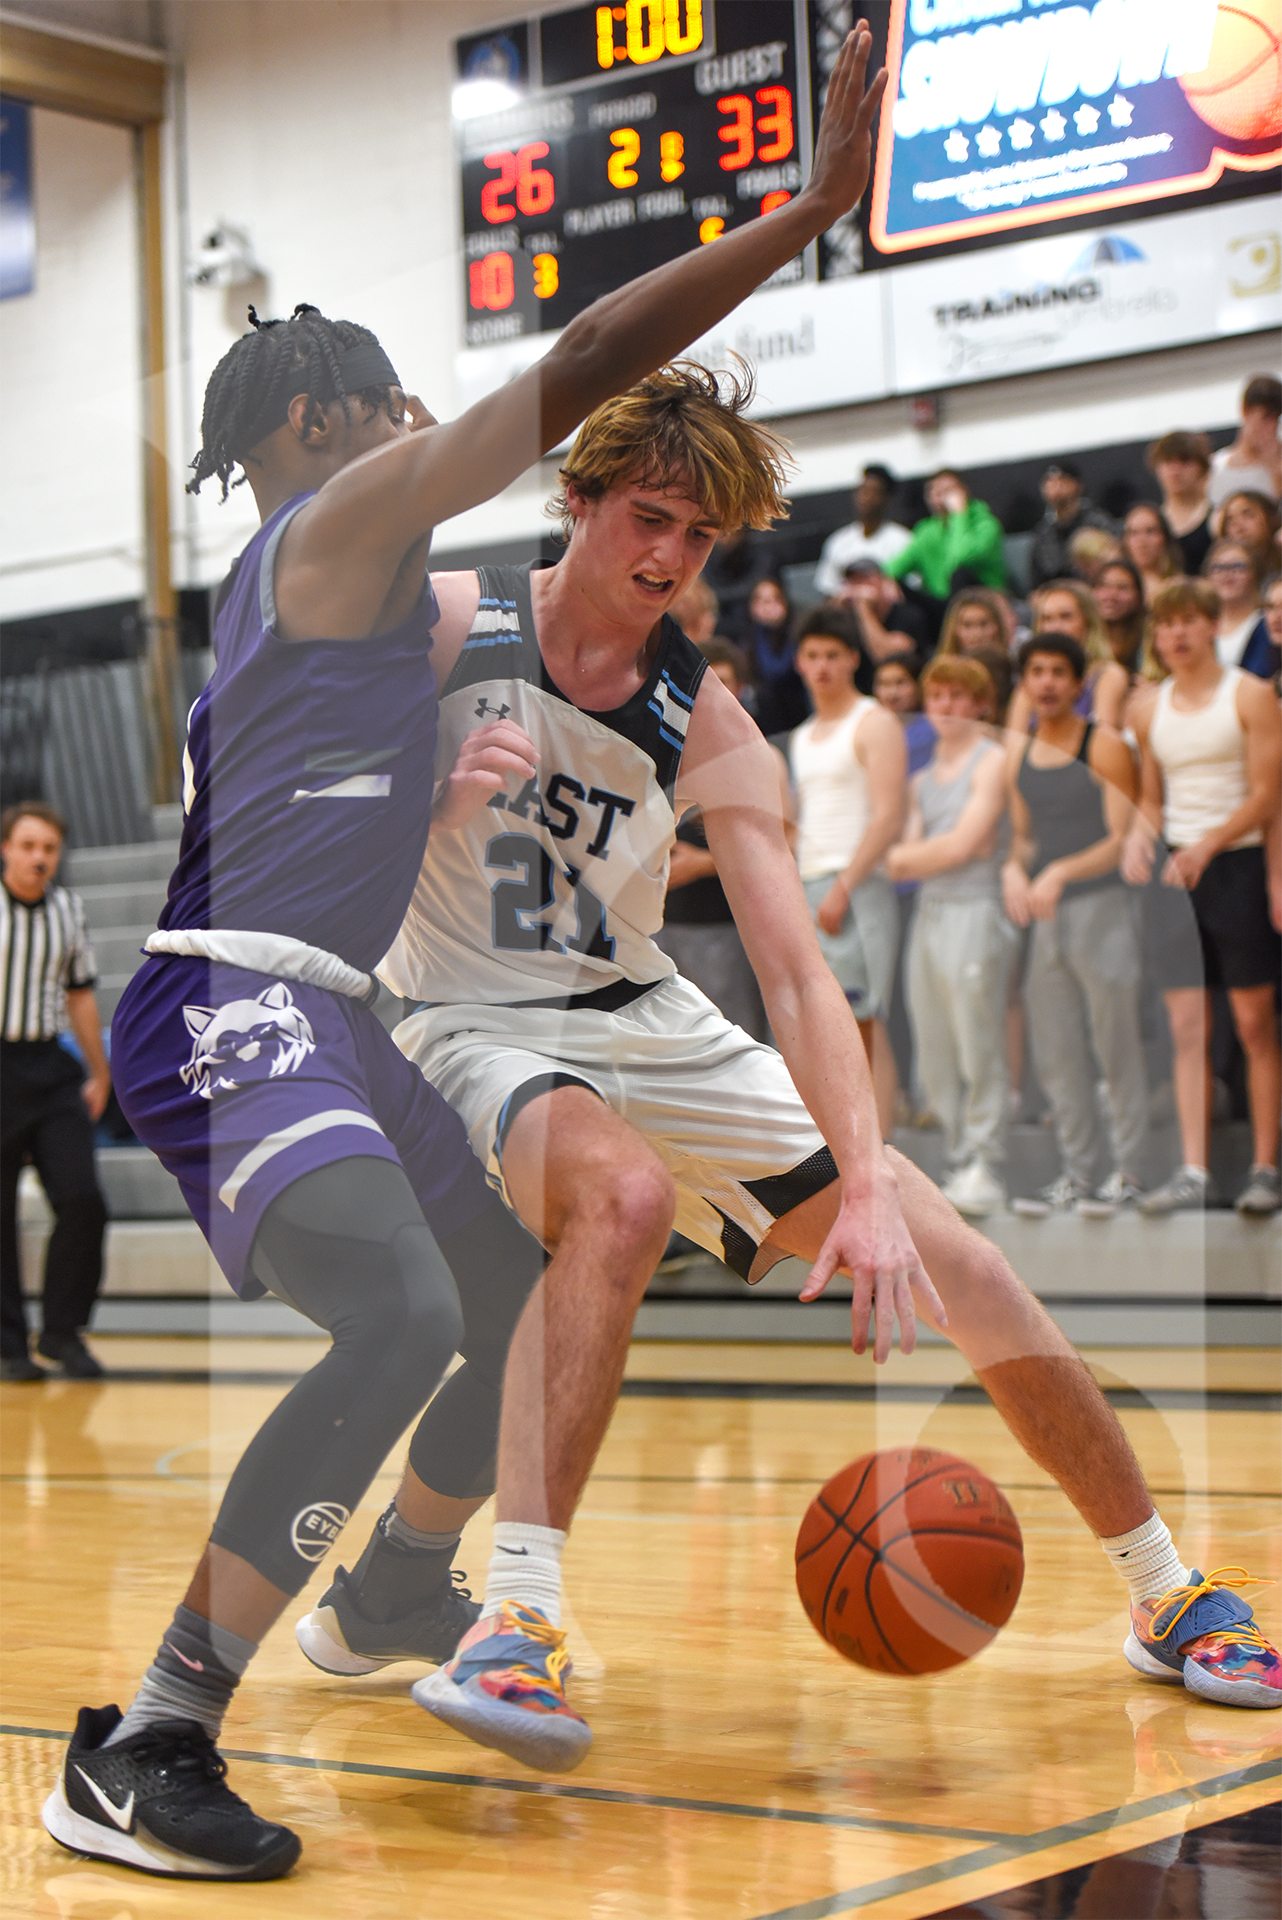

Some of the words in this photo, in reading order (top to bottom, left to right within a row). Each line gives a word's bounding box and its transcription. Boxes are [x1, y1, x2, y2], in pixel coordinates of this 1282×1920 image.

[596, 0, 704, 69] 1:00
[695, 42, 787, 94] GUEST
[716, 85, 794, 171] 33
[481, 141, 555, 224] 26
[469, 251, 515, 311] 10
[532, 252, 559, 299] 3
[487, 772, 636, 861] AST
[485, 831, 617, 961] 21
